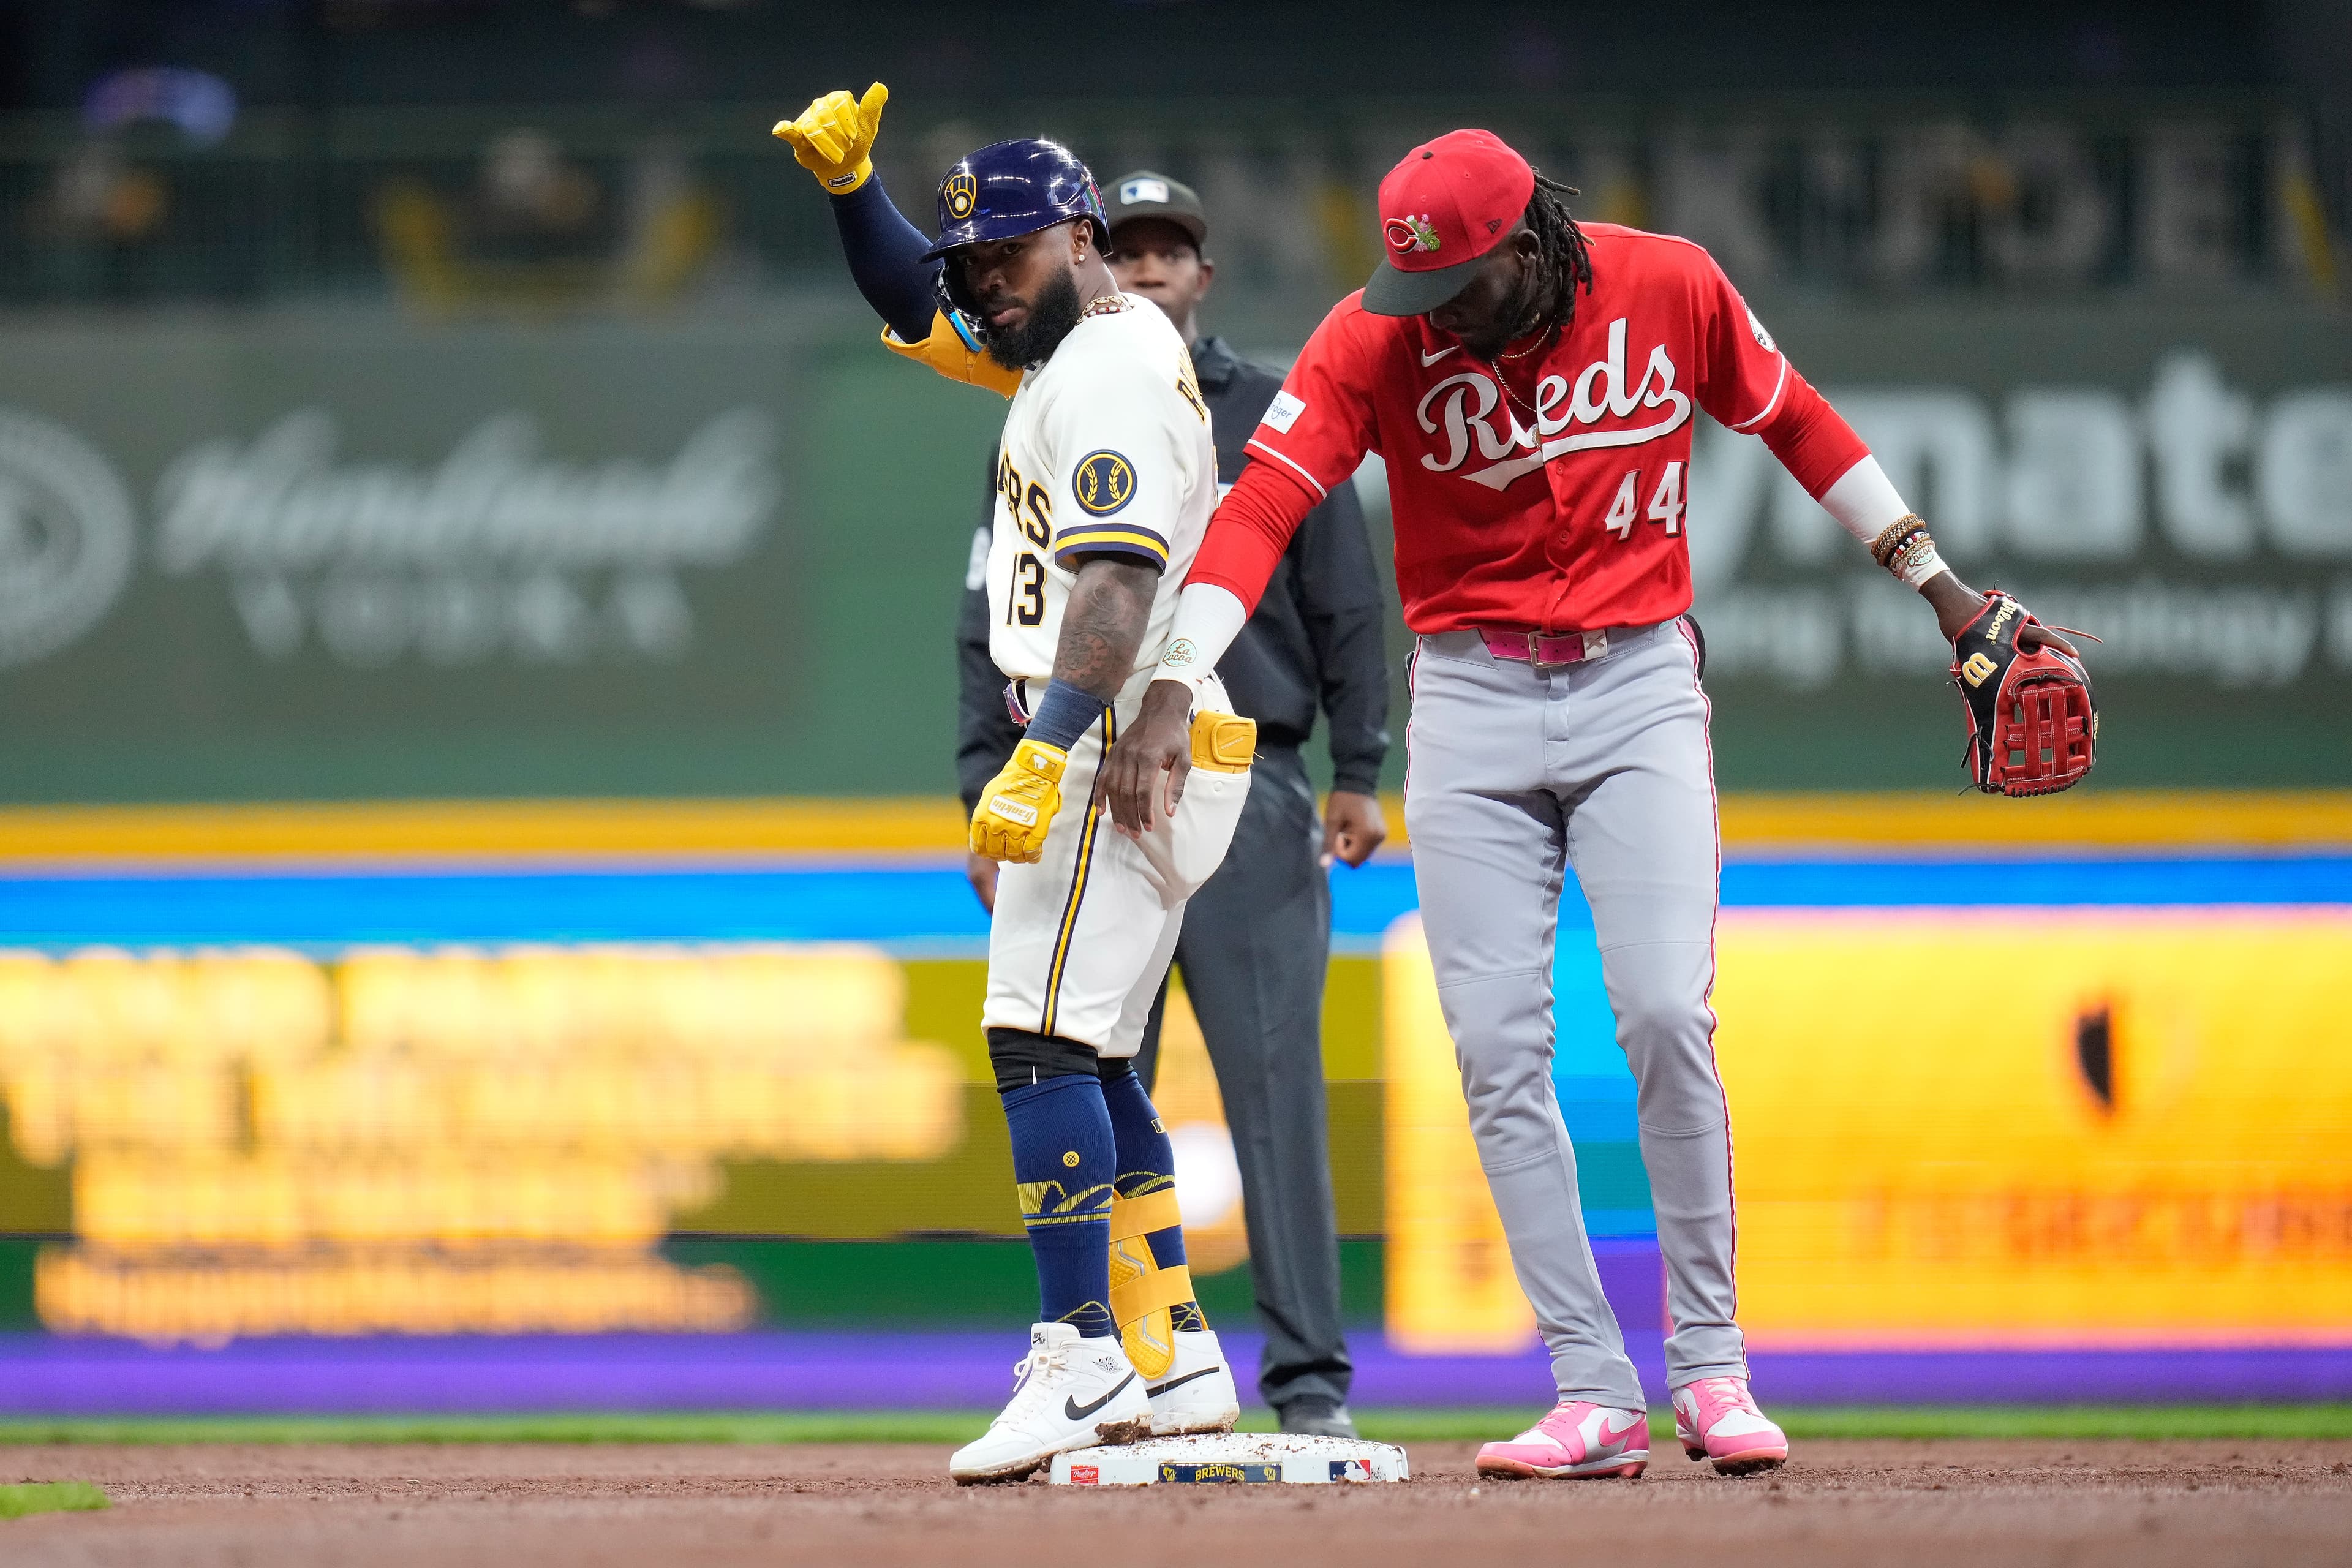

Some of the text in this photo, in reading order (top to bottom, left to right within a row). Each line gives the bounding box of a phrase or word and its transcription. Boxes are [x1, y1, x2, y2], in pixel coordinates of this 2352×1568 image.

[1417, 317, 1692, 475] Reds
[1604, 460, 1688, 542] 44
[1005, 551, 1047, 627] 13
[1162, 651, 1193, 663] Cocoa
[1173, 643, 1191, 655] La
[1195, 1466, 1245, 1482] BREWERS
